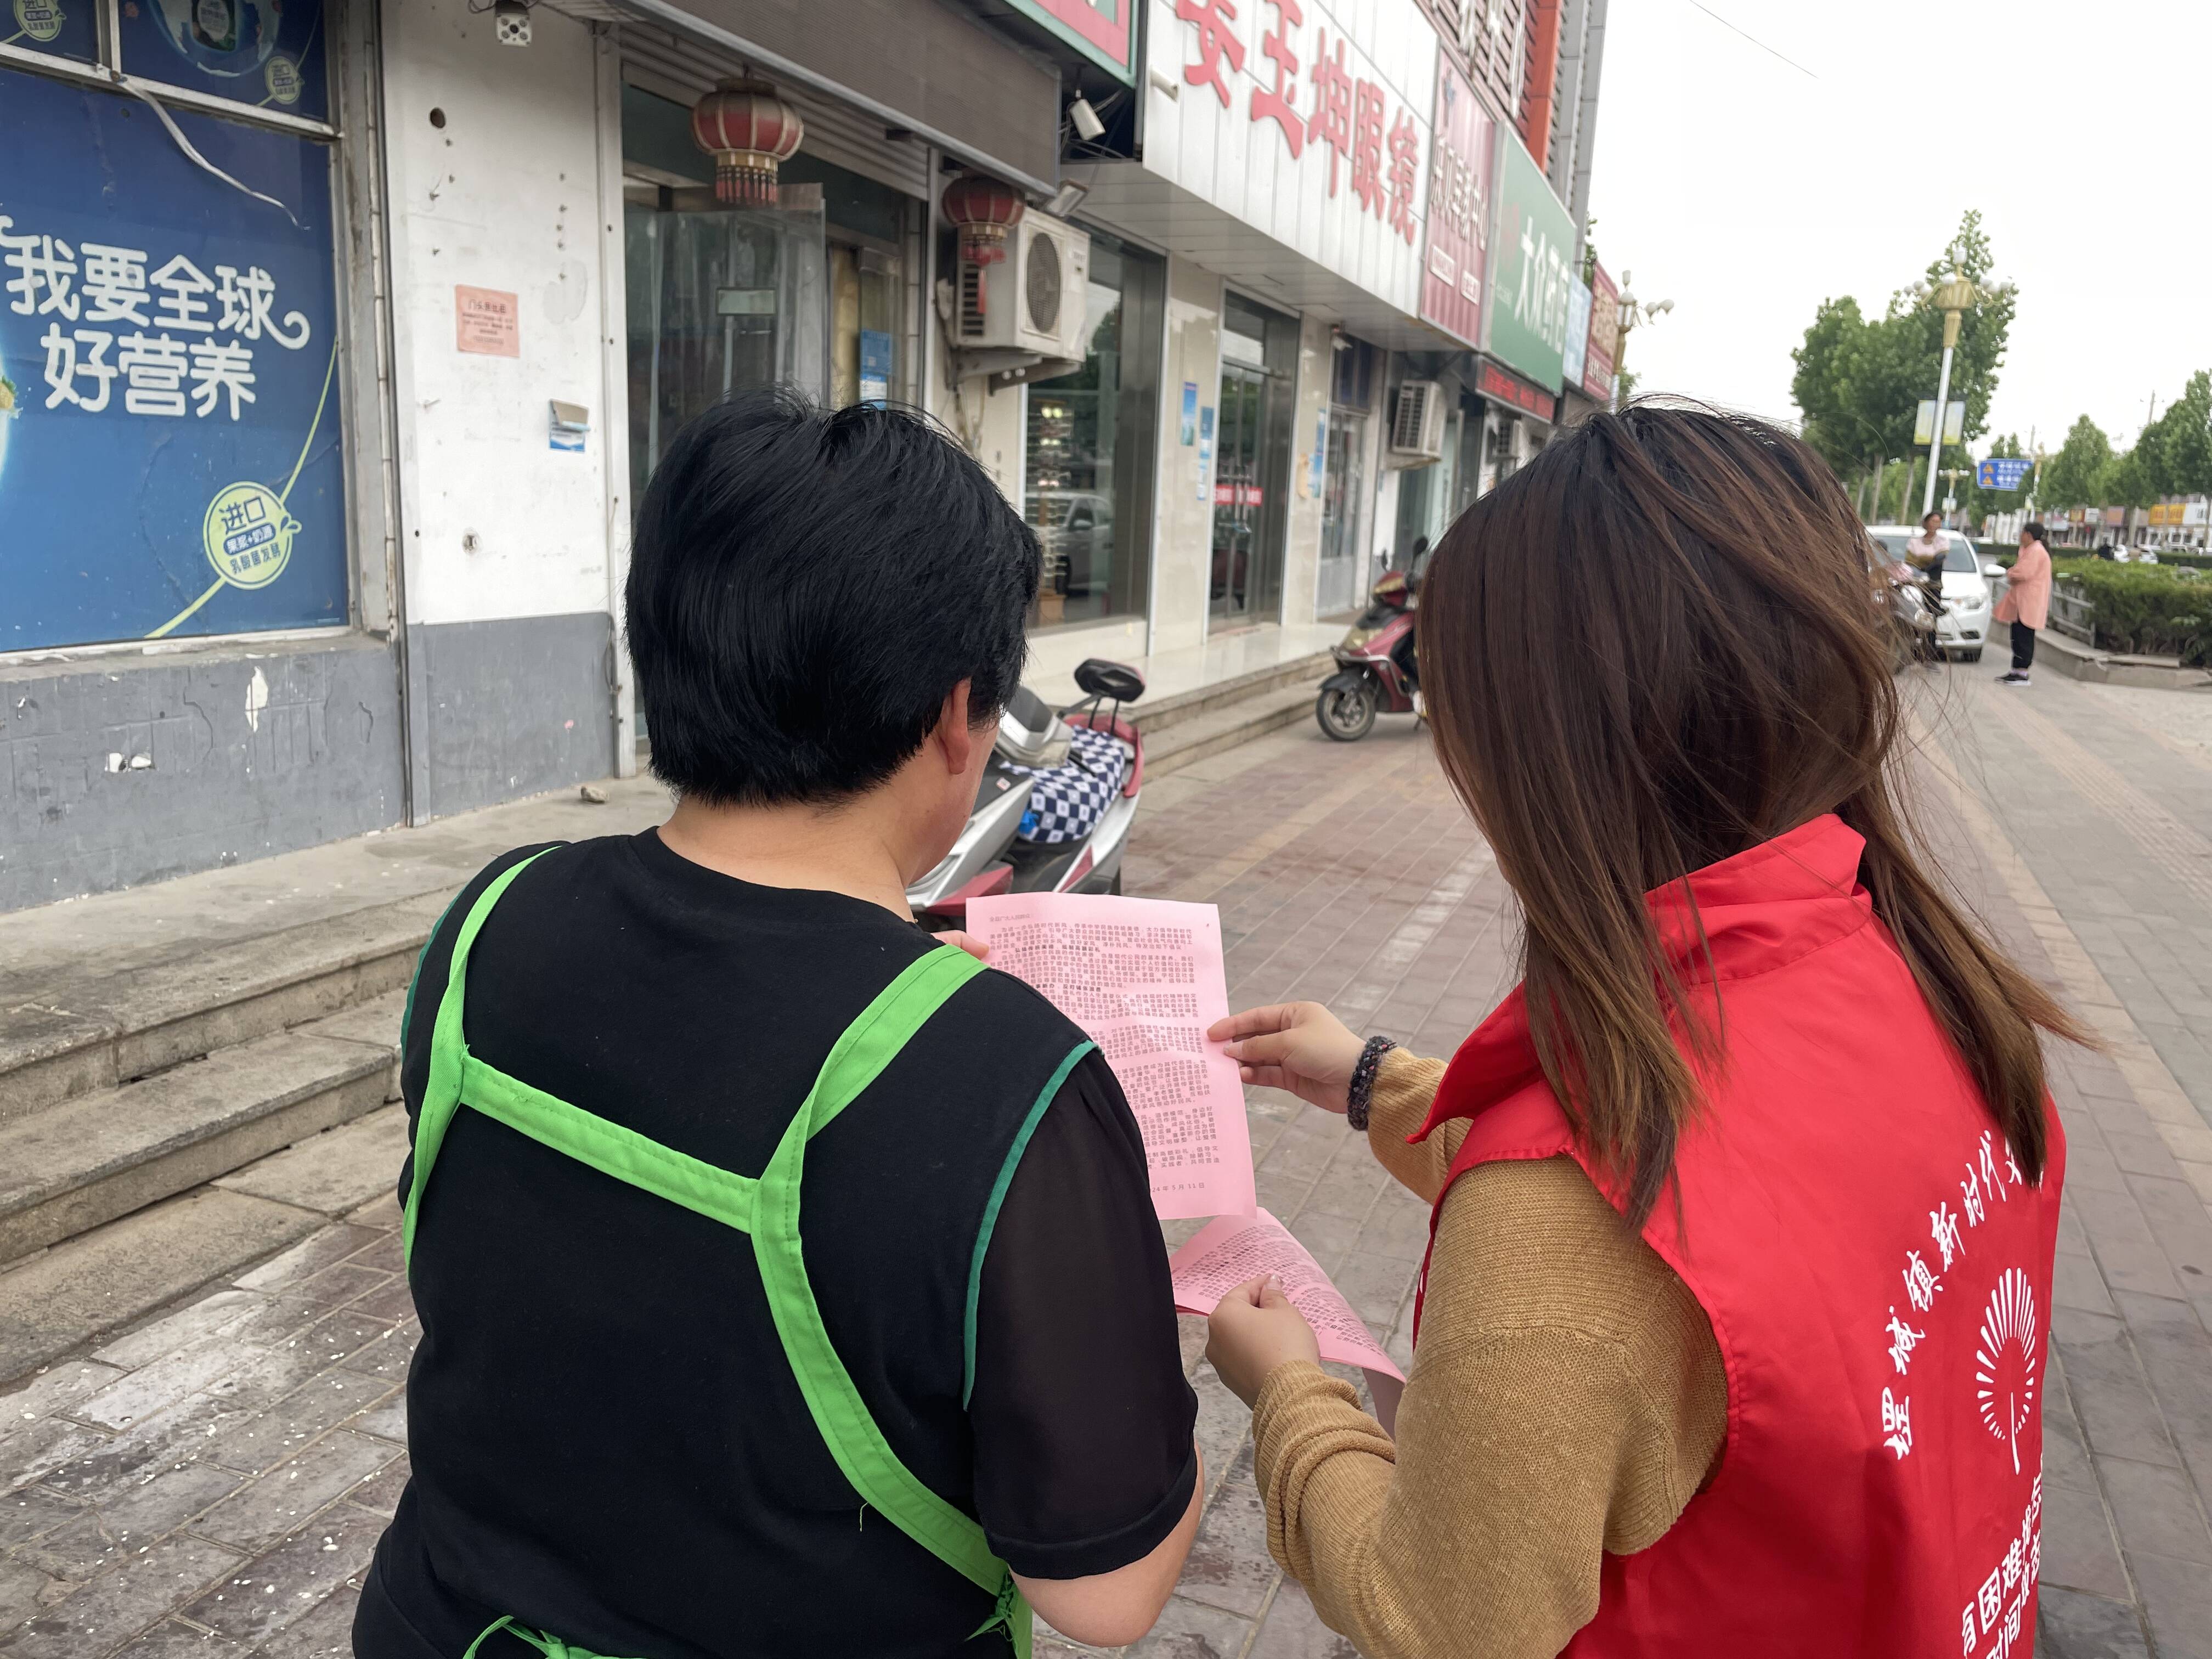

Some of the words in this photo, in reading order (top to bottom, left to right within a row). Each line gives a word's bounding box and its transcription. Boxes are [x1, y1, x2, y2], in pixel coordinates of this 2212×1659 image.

[0, 216, 311, 349] 我要全球
[40, 323, 257, 421] 好营养
[219, 496, 266, 535] 进口
[230, 542, 281, 574] 乳酸菌发酵
